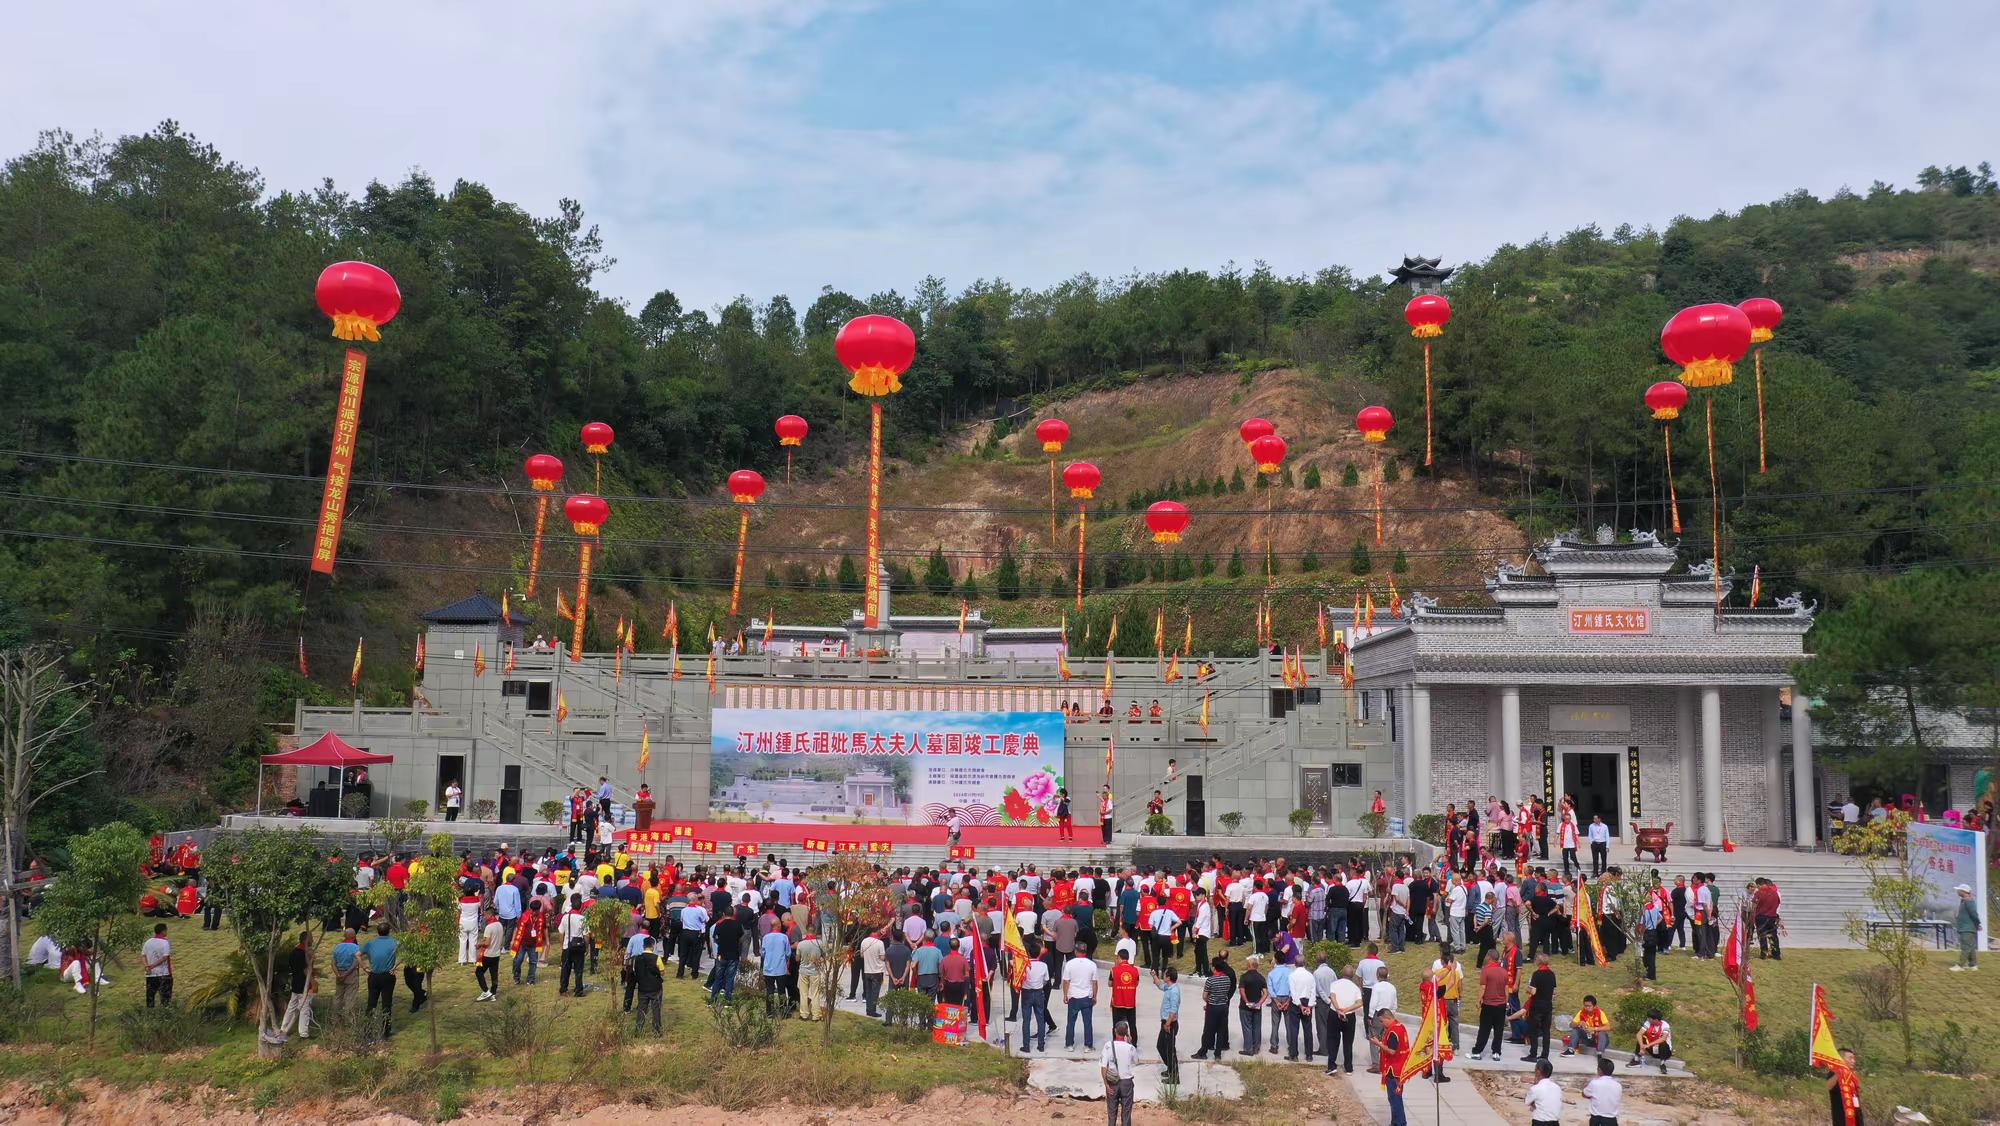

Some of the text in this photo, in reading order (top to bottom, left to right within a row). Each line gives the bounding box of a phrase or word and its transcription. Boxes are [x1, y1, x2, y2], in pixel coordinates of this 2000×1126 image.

[736, 731, 1040, 757] 汀州鍾氏祖妣馬太夫人墓園竣工慶典
[674, 826, 692, 836] 福建
[651, 832, 671, 841] 海南
[630, 842, 652, 852] 新加坡
[696, 841, 713, 851] 台湾
[736, 845, 755, 854] 广东
[870, 842, 889, 852] 重庆
[951, 848, 971, 857] 四川
